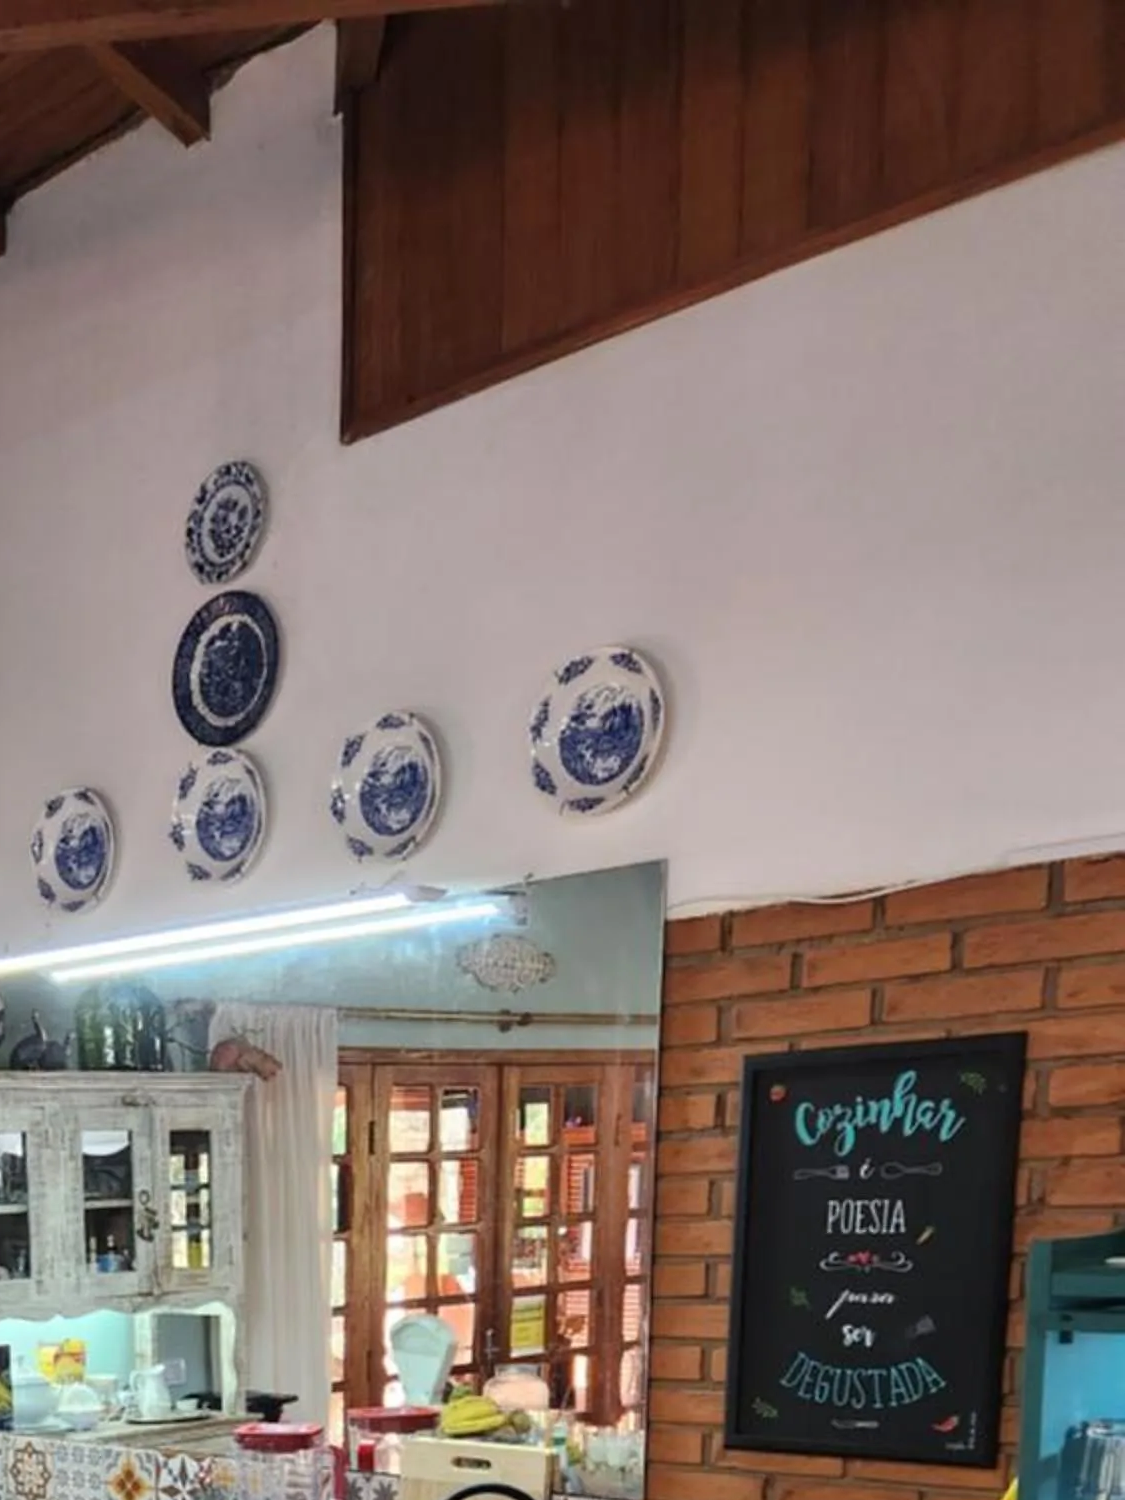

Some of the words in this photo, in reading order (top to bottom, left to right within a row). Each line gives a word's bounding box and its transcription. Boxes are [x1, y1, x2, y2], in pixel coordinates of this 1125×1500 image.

[795, 1071, 965, 1155] Cozinhar
[827, 1200, 906, 1234] POESIA
[842, 1324, 875, 1347] ser
[780, 1353, 946, 1408] DEGUSTADA
